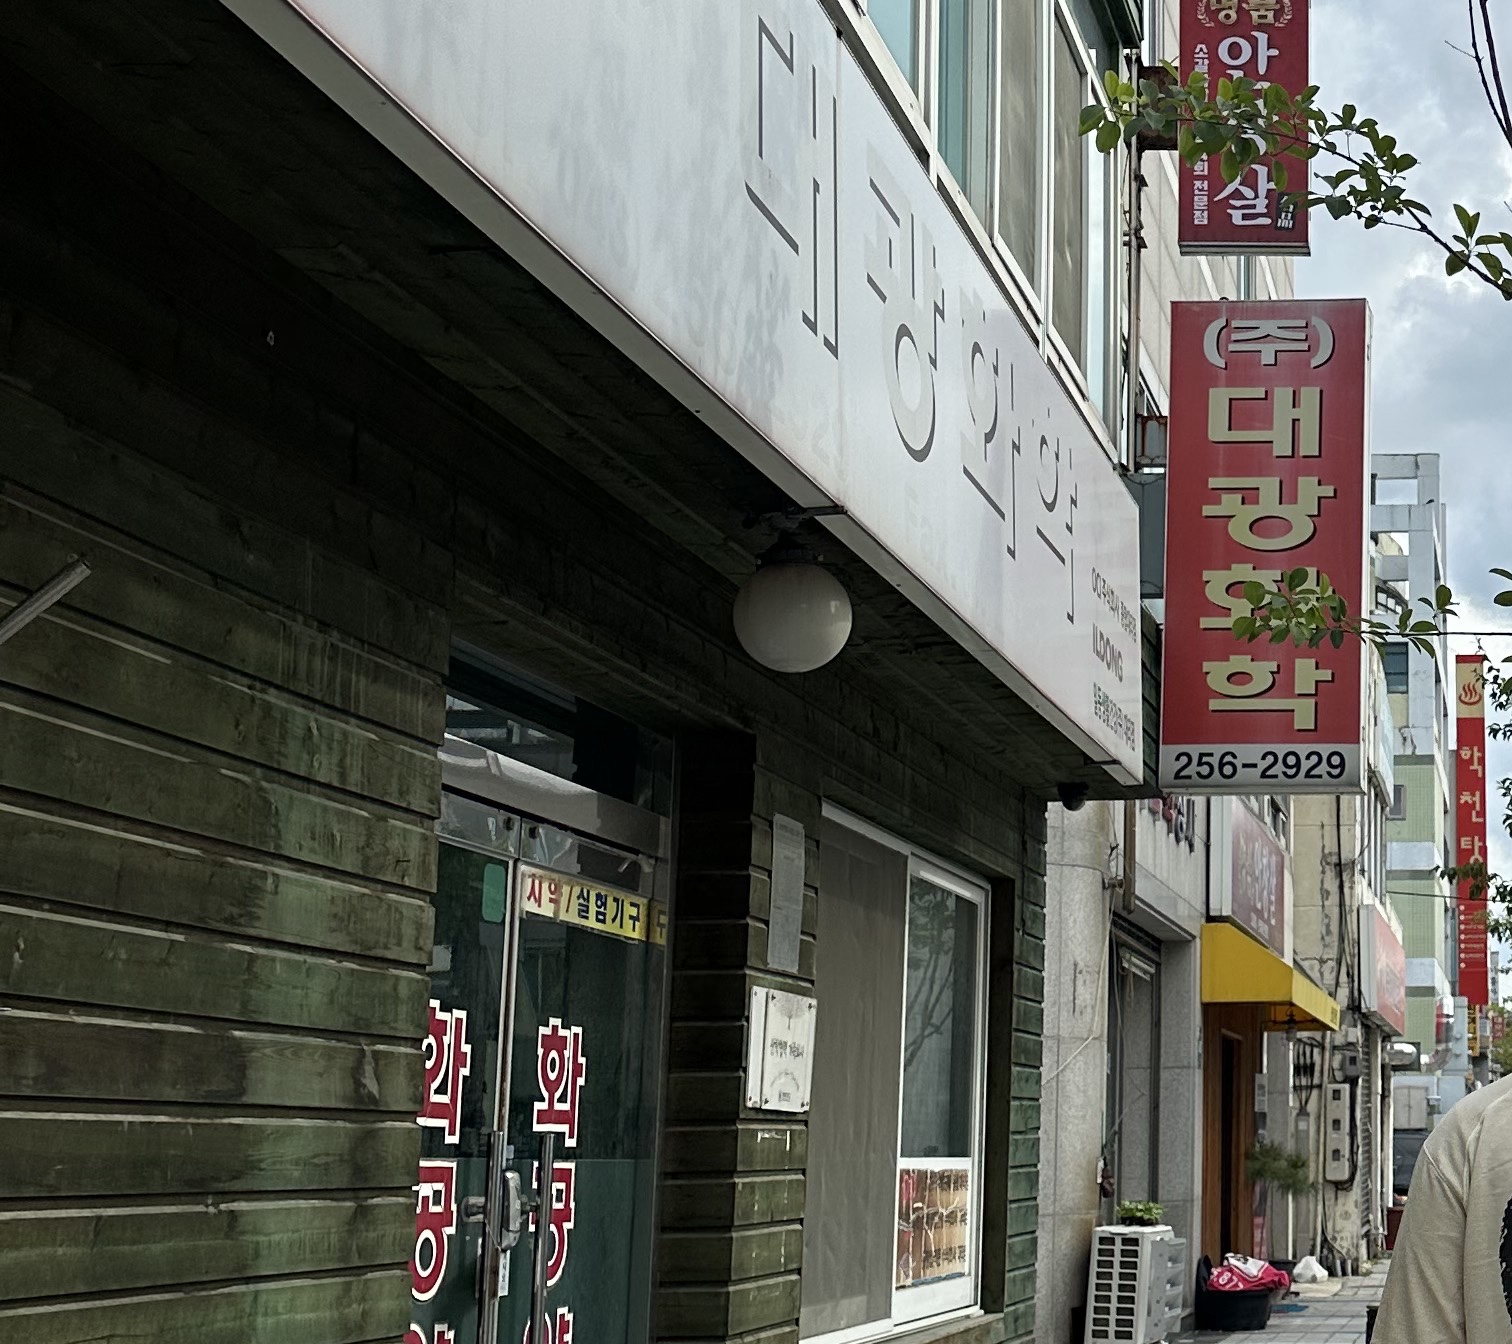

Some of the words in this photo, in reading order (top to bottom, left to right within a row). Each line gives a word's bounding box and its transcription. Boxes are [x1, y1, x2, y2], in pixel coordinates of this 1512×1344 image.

[1213, 30, 1280, 226] 안살
[1203, 316, 1335, 369] (주)
[1199, 386, 1337, 733] 대광화학
[1093, 623, 1123, 683] ILDONG
[1173, 750, 1346, 781] 256-2929
[1460, 746, 1483, 864] 학천탕
